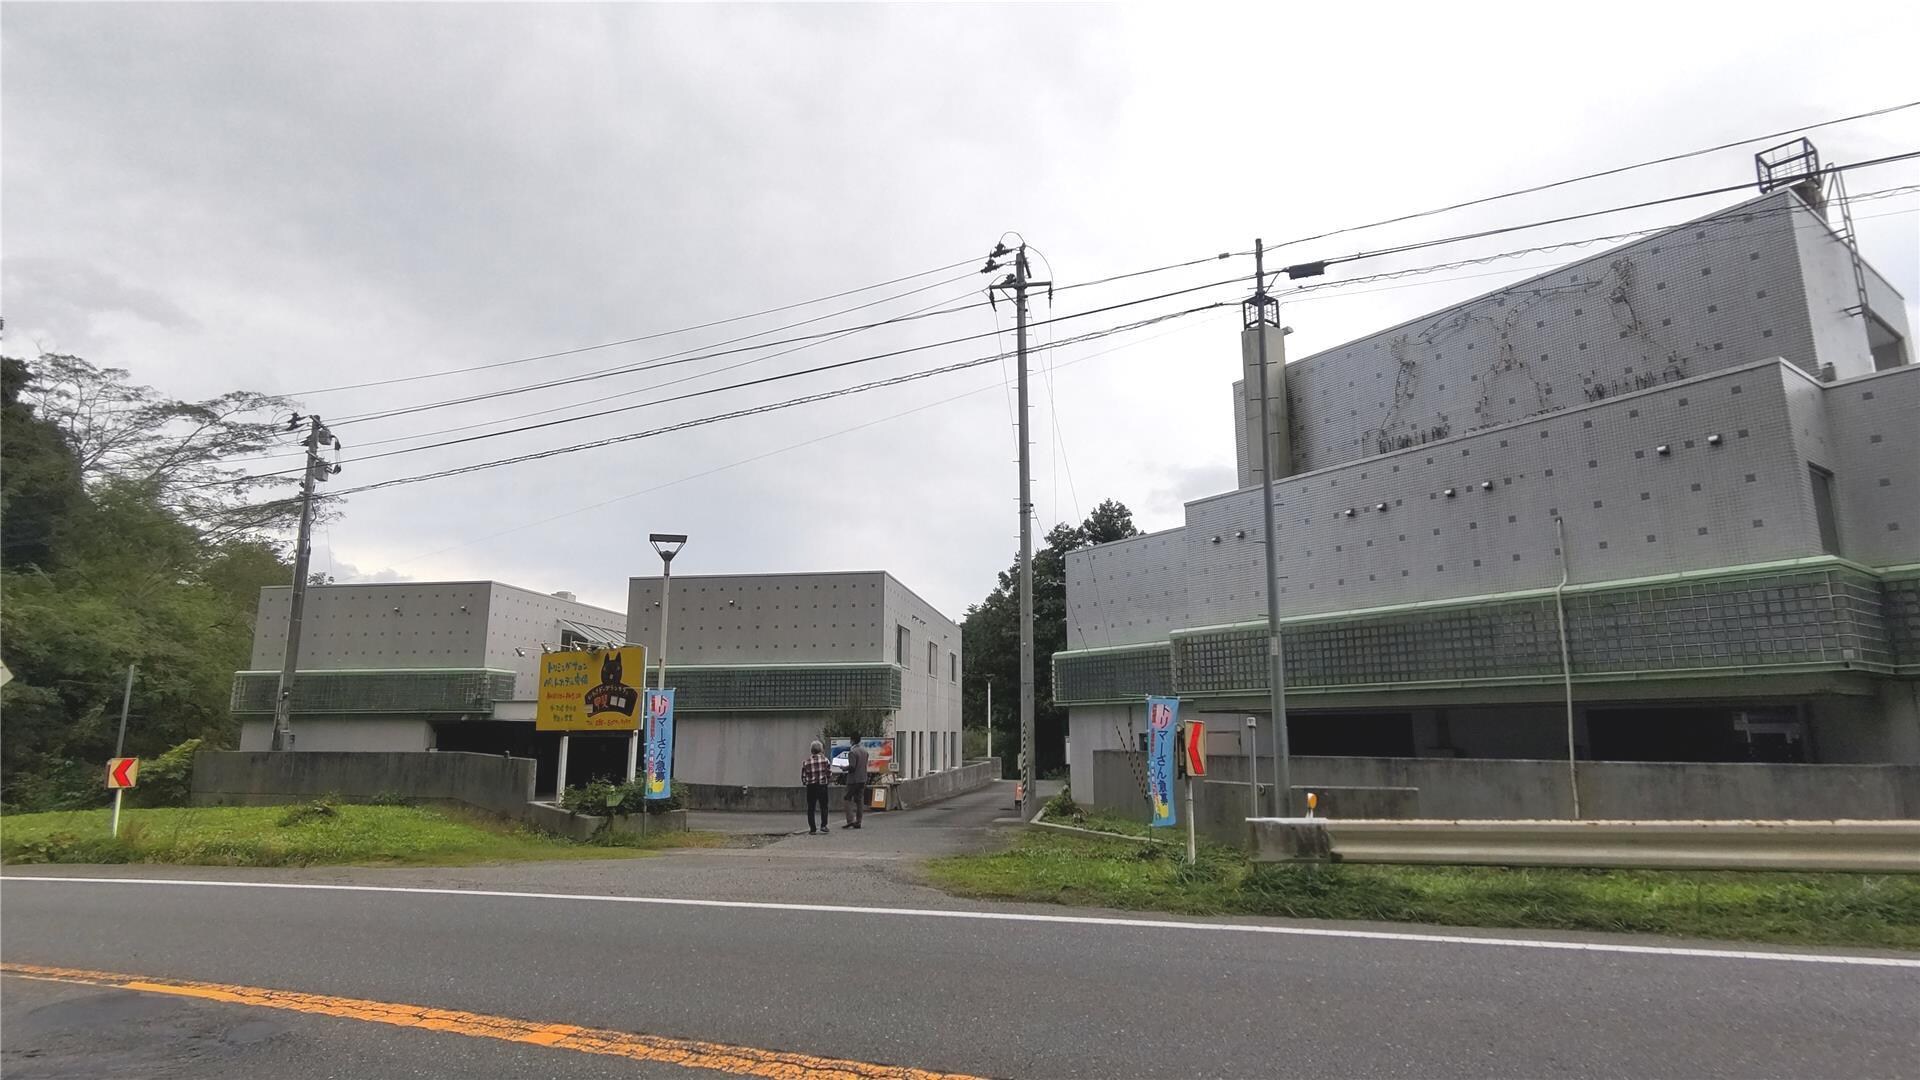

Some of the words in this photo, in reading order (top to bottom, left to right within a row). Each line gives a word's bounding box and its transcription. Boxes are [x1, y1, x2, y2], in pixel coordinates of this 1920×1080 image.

[655, 695, 668, 783] トリマーさん急募
[1157, 704, 1170, 806] トリマーさん急募
